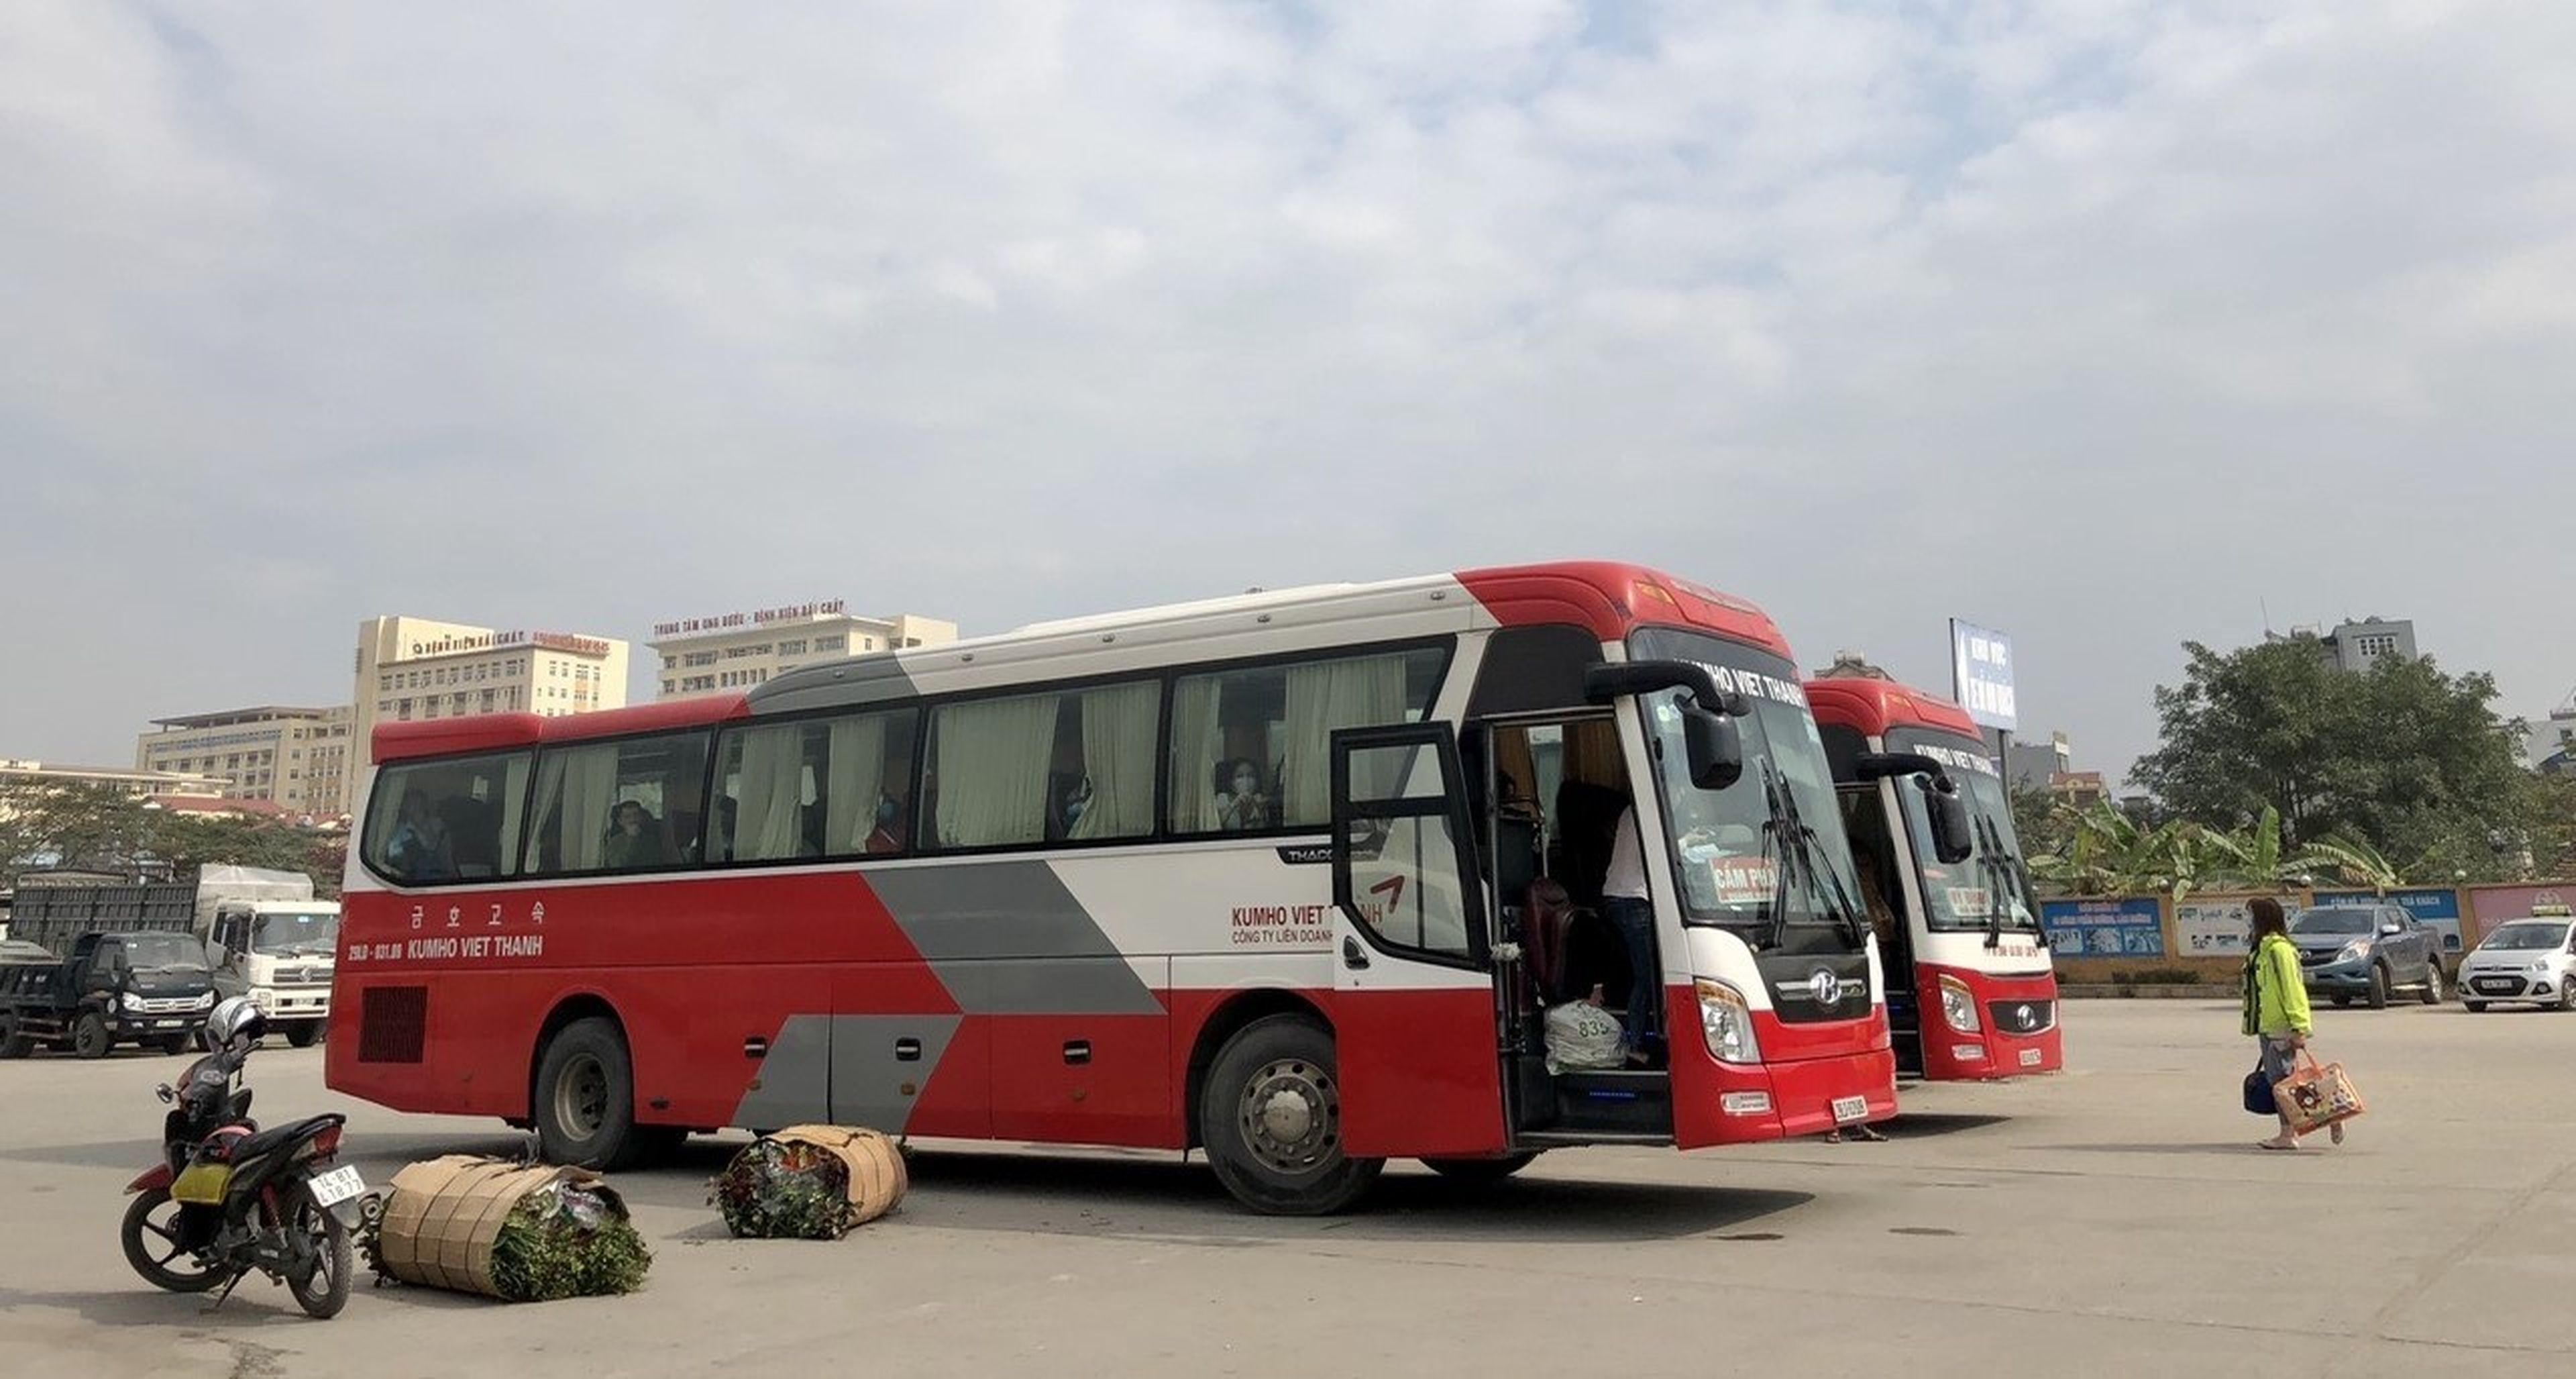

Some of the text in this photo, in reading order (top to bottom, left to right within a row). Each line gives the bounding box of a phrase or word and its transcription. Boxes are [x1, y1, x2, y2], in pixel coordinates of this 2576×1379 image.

[1731, 668, 1765, 697] VIET
[1762, 676, 1806, 709] THANH
[1232, 907, 1287, 927] KUMHO
[1291, 905, 1325, 925] VIET
[1232, 929, 1260, 943] CÔNG
[1262, 930, 1274, 943] TY
[1276, 927, 1299, 943] LIÊN
[407, 938, 458, 960] KUMHO
[460, 936, 492, 958] VIET
[493, 935, 543, 957] THANH
